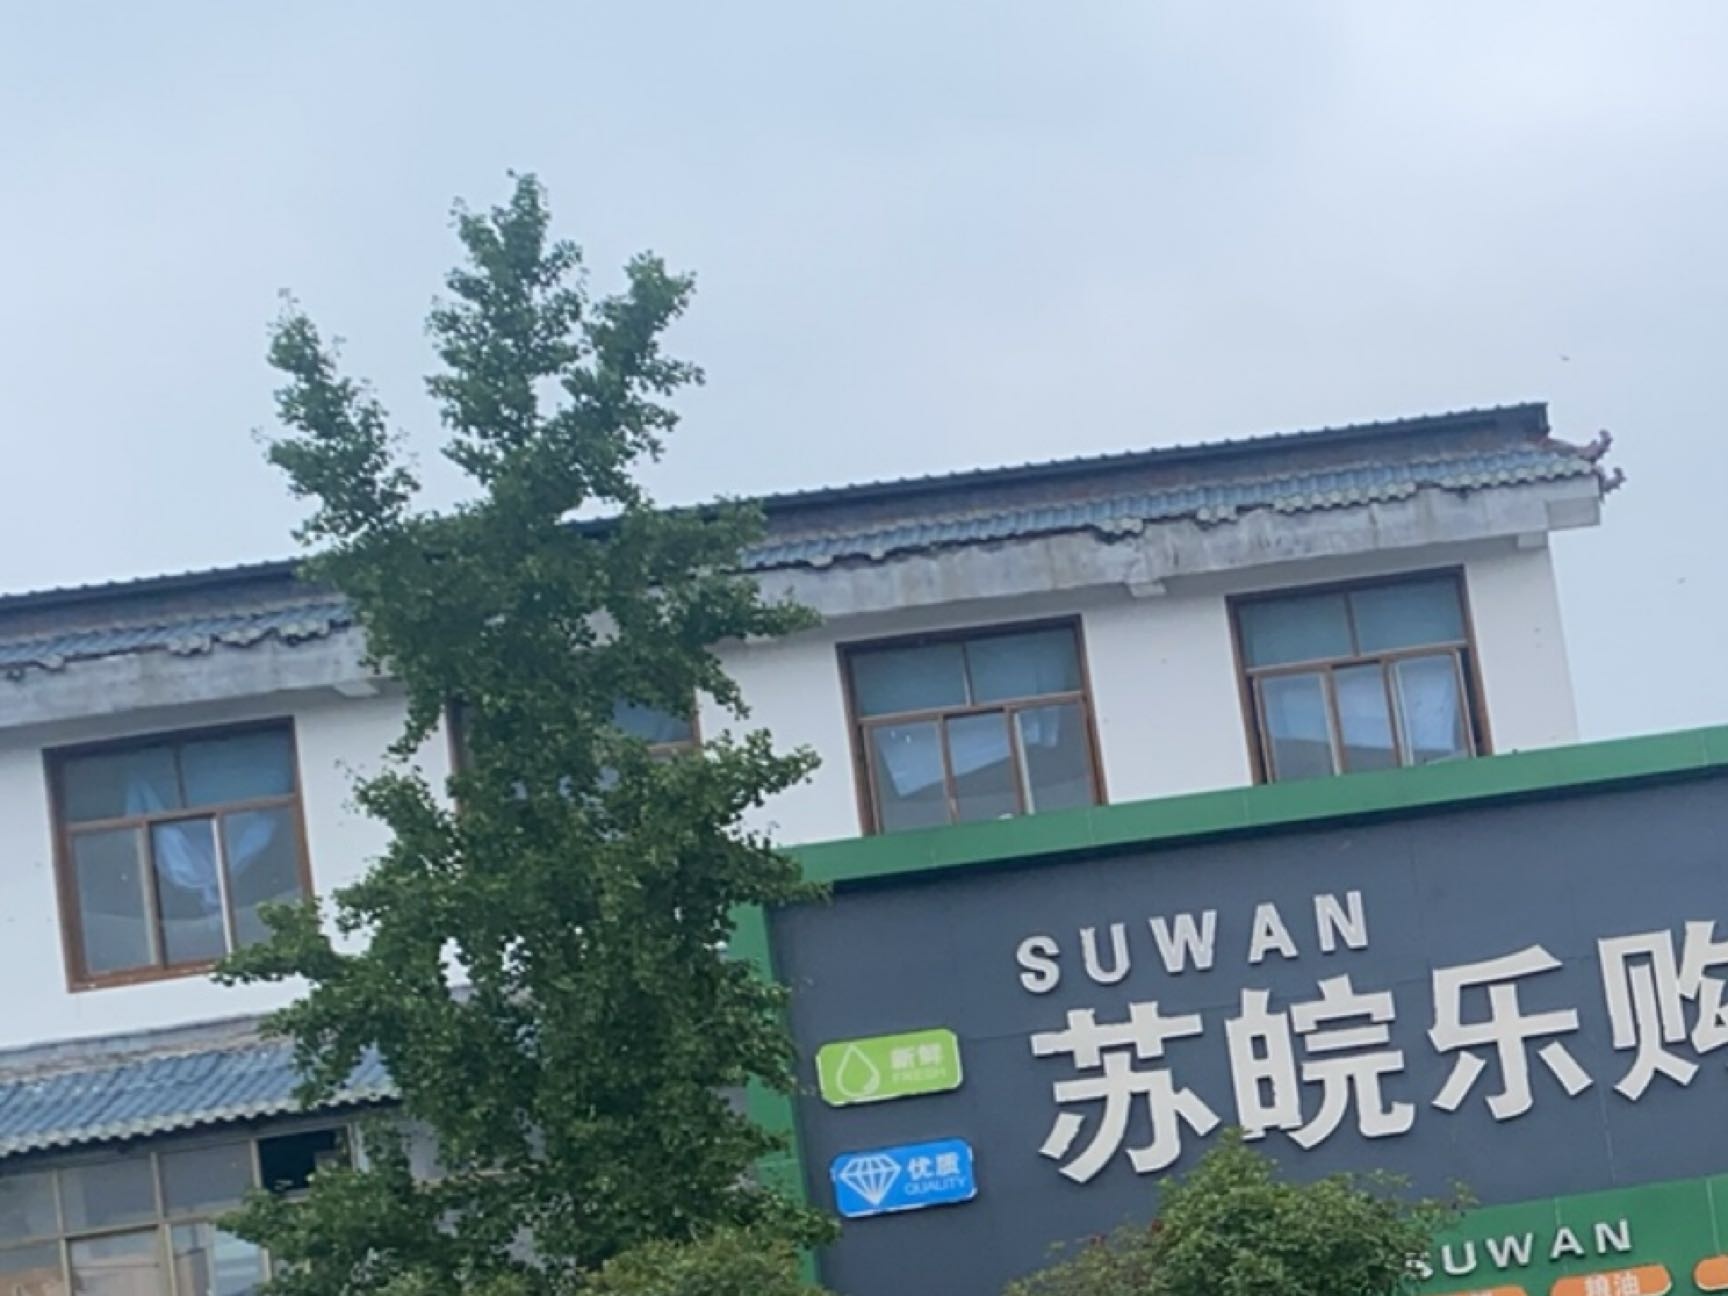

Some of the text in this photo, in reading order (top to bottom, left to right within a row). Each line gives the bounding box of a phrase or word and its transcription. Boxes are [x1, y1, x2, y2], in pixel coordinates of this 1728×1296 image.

[1016, 890, 1370, 994] SUWAN
[890, 1043, 943, 1071] 新鲜
[907, 1151, 960, 1181] 优质
[904, 1175, 967, 1197] QUALITY
